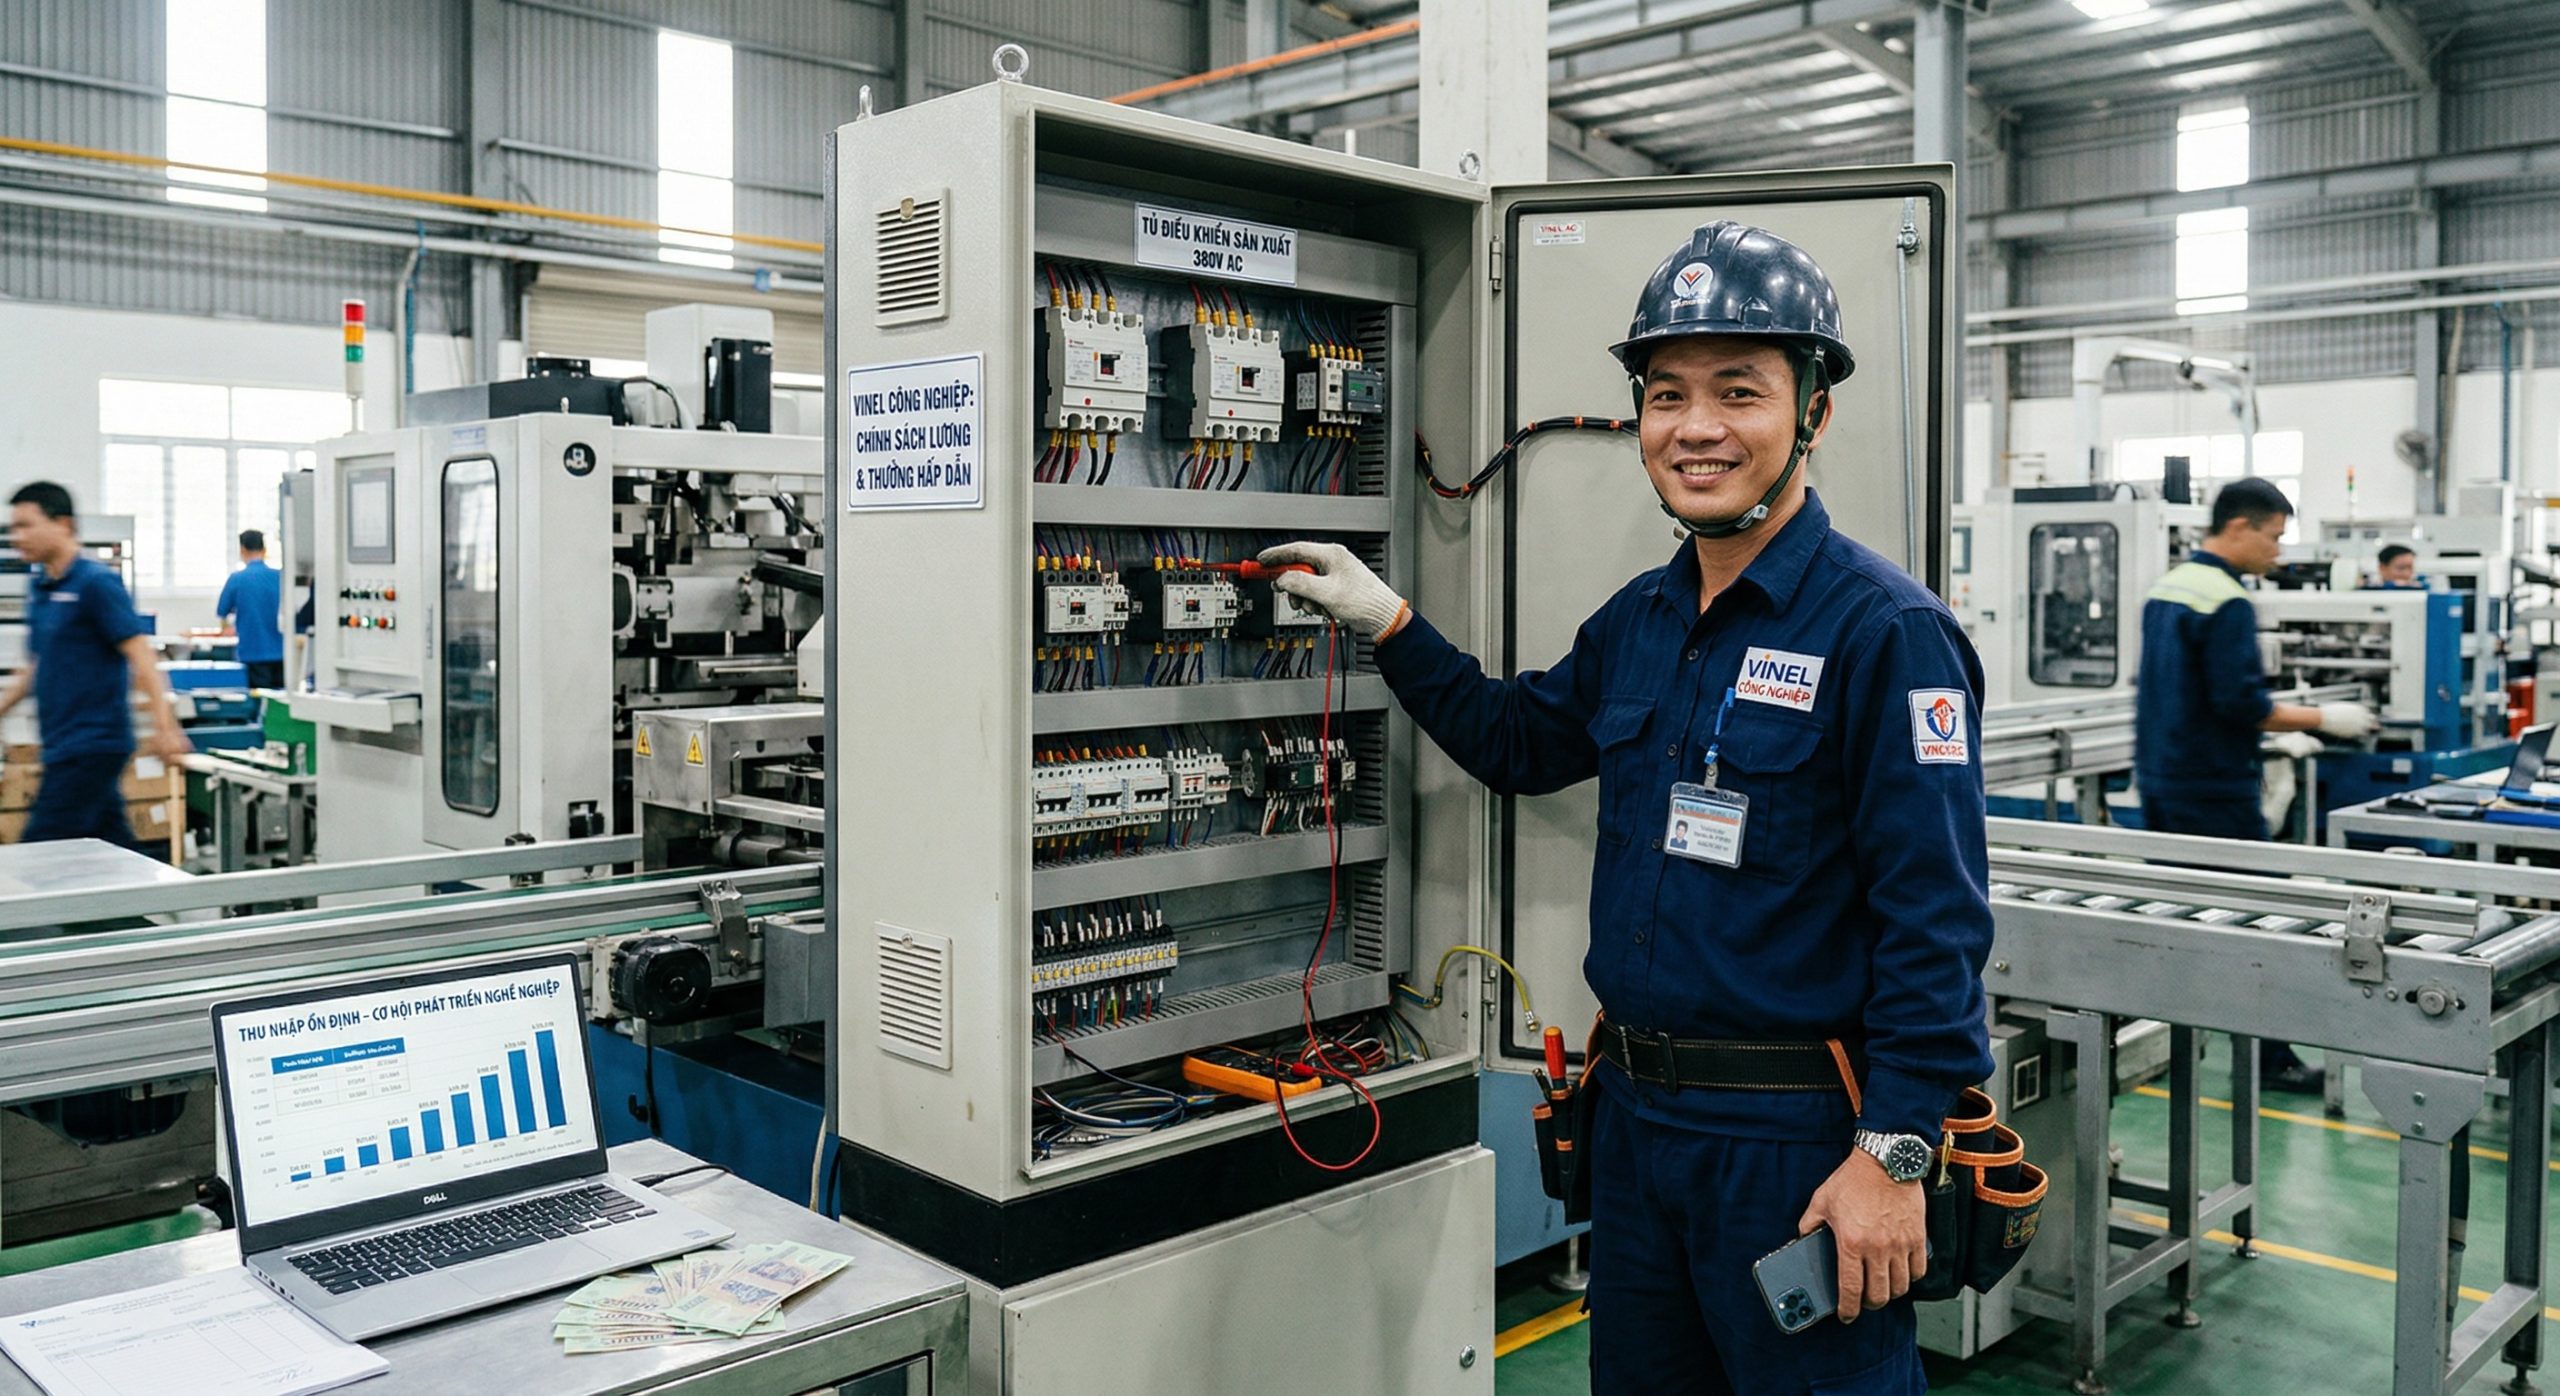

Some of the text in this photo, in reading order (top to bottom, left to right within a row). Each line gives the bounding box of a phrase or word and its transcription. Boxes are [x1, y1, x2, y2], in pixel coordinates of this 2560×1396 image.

[1142, 212, 1158, 236] TỦ
[1234, 228, 1258, 251] SẢN
[1194, 250, 1243, 272] 380V AC
[854, 379, 974, 416] VINEL CÔNG NGHIỆP:
[856, 422, 971, 453] CHÍNH SÁCH LƯƠNG
[856, 468, 865, 490] &
[918, 456, 941, 487] HẤP
[946, 453, 971, 486] DẪN
[1748, 654, 1812, 687] VINEL
[1766, 686, 1810, 704] NGHIỆP
[238, 1026, 266, 1042] THU
[270, 1018, 305, 1037] NHẬP
[329, 1011, 361, 1030] ĐỊNH
[372, 1006, 388, 1021] CƠ
[390, 1000, 412, 1020] HỘI
[415, 996, 446, 1015] PHÁT
[518, 979, 560, 998] NGHIỆP
